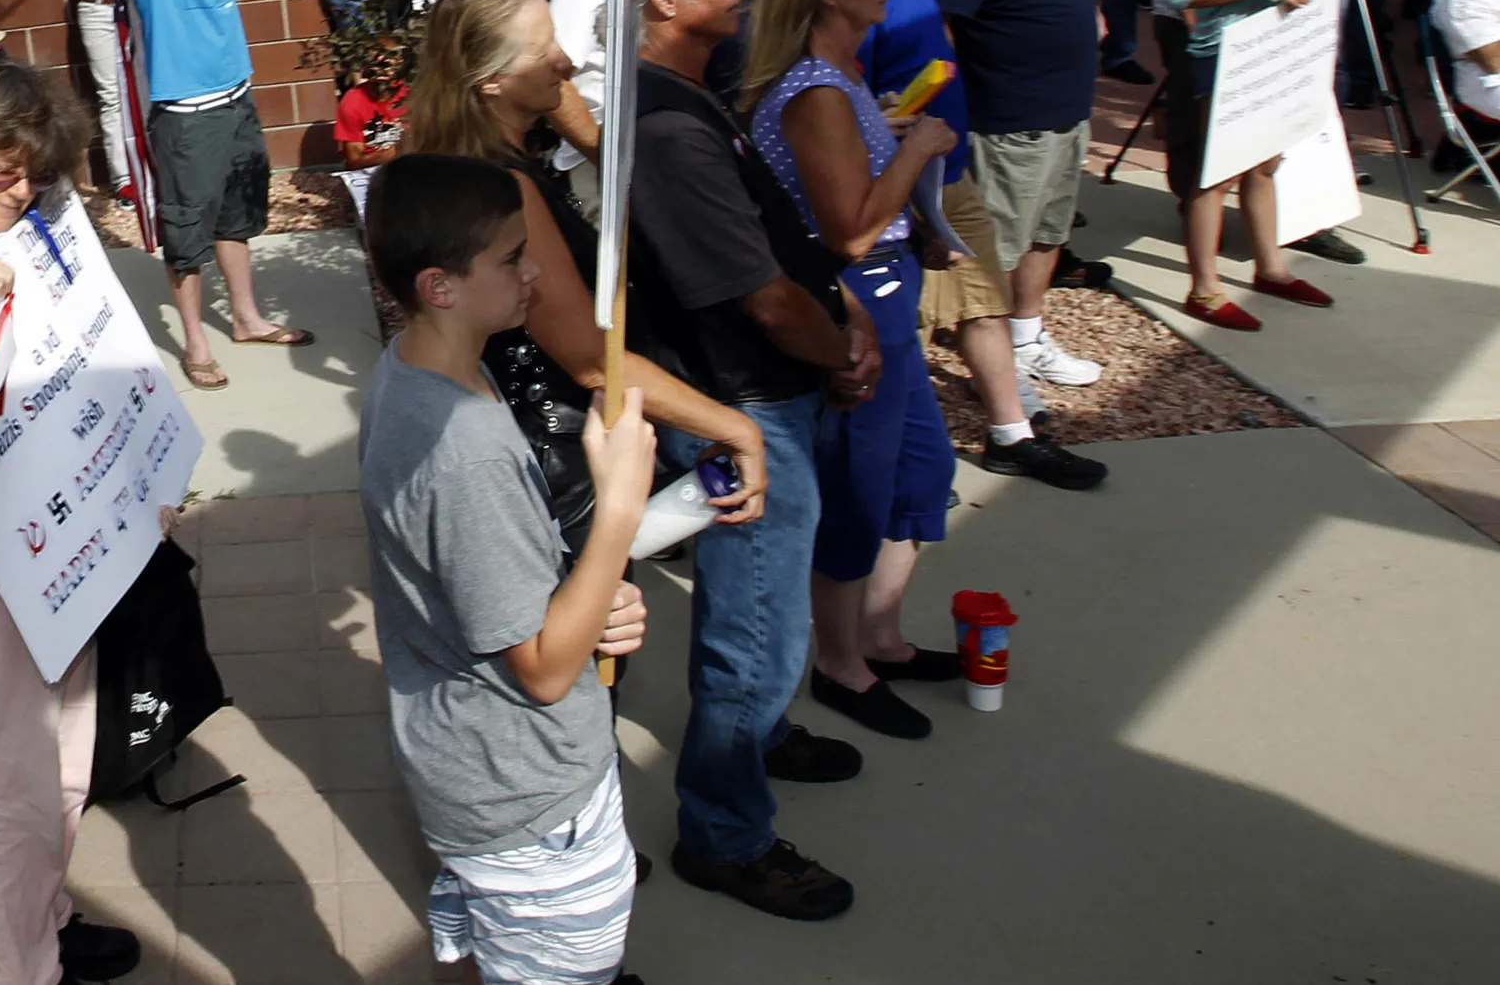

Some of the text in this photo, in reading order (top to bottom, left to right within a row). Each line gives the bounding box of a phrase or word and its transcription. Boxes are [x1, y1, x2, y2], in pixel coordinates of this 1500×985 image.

[20, 345, 89, 421] Snooping
[71, 398, 106, 441] wish
[41, 528, 110, 614] HAPPY
